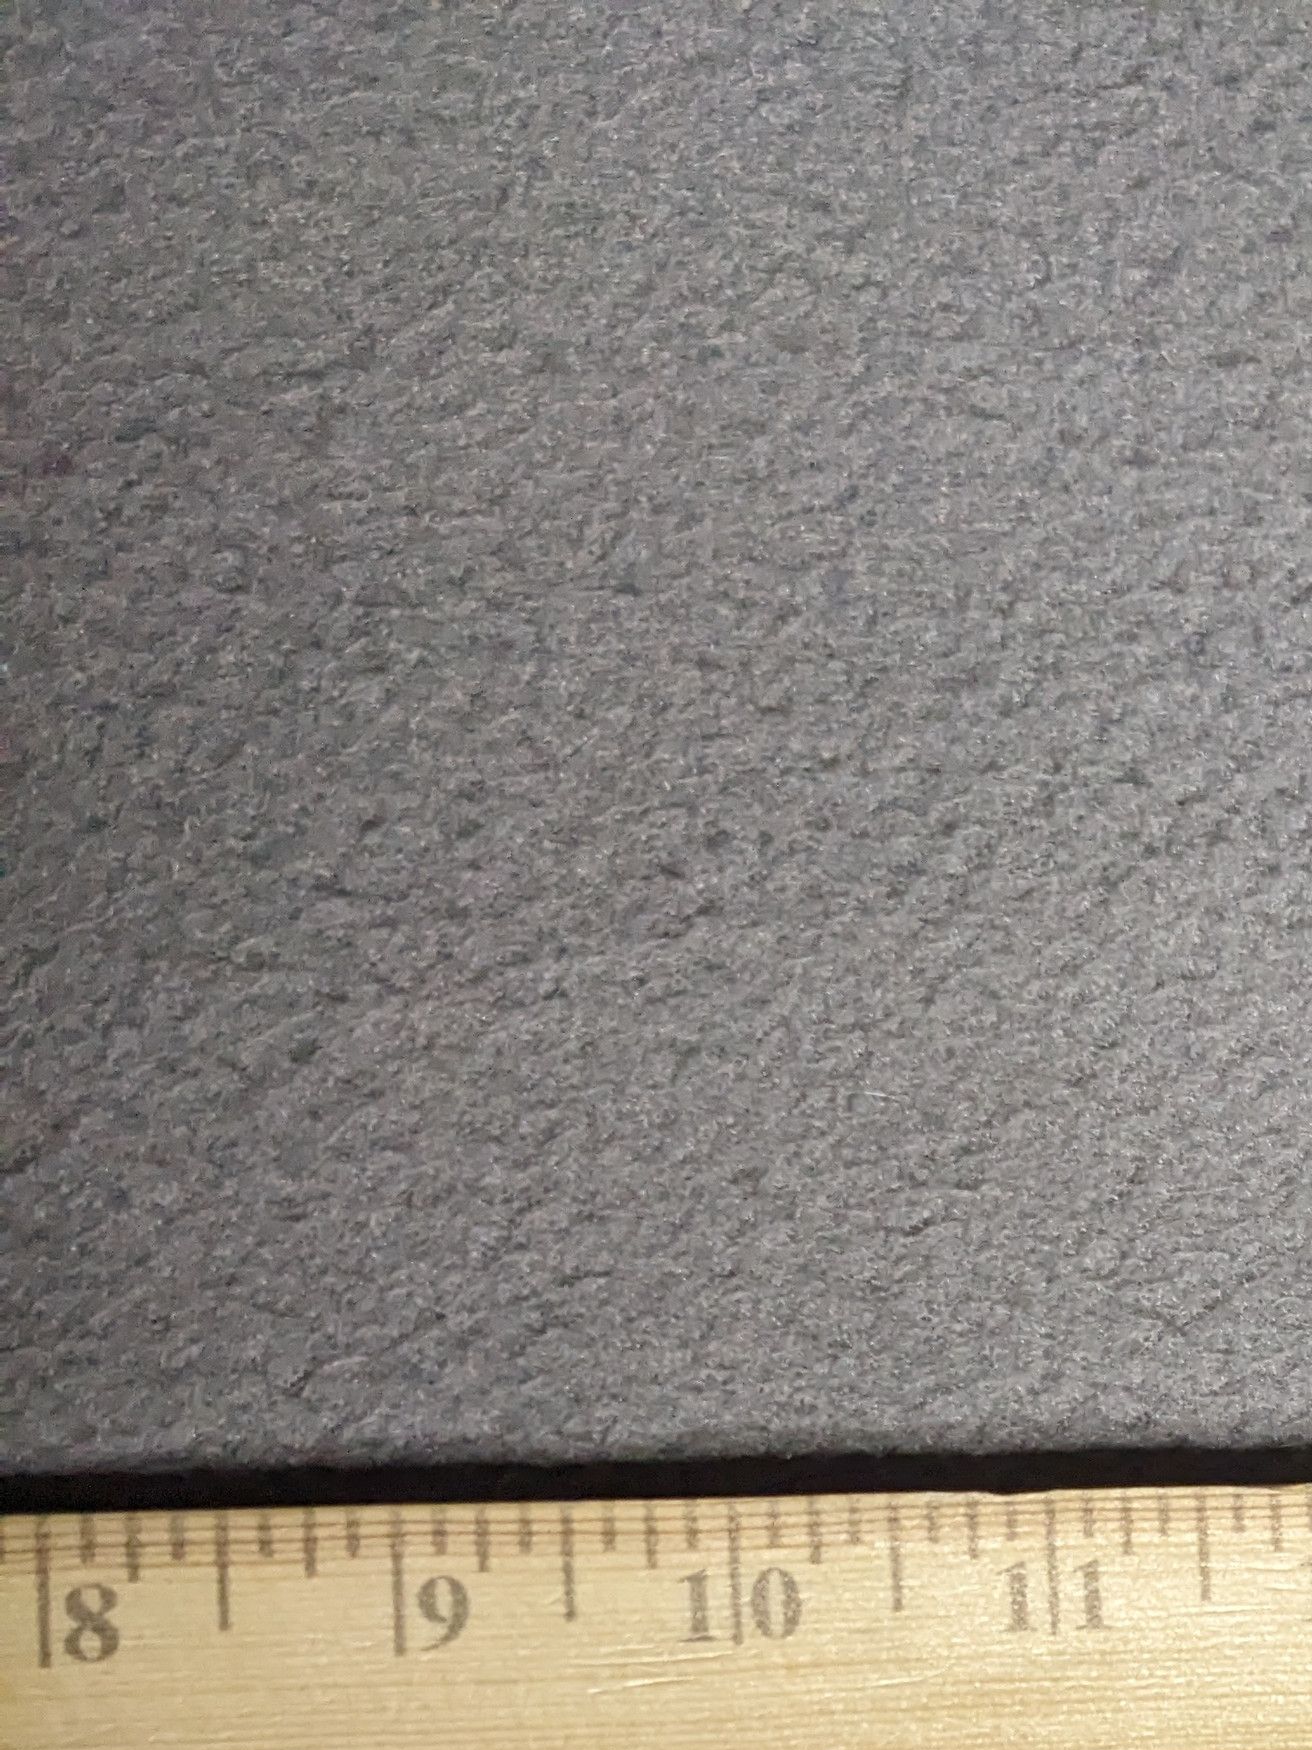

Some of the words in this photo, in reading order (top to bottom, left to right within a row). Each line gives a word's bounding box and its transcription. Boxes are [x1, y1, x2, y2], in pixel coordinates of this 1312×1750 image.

[64, 1583, 119, 1662] 8
[418, 1572, 470, 1650] 9
[677, 1566, 803, 1644] 10
[1001, 1558, 1114, 1634] 11
